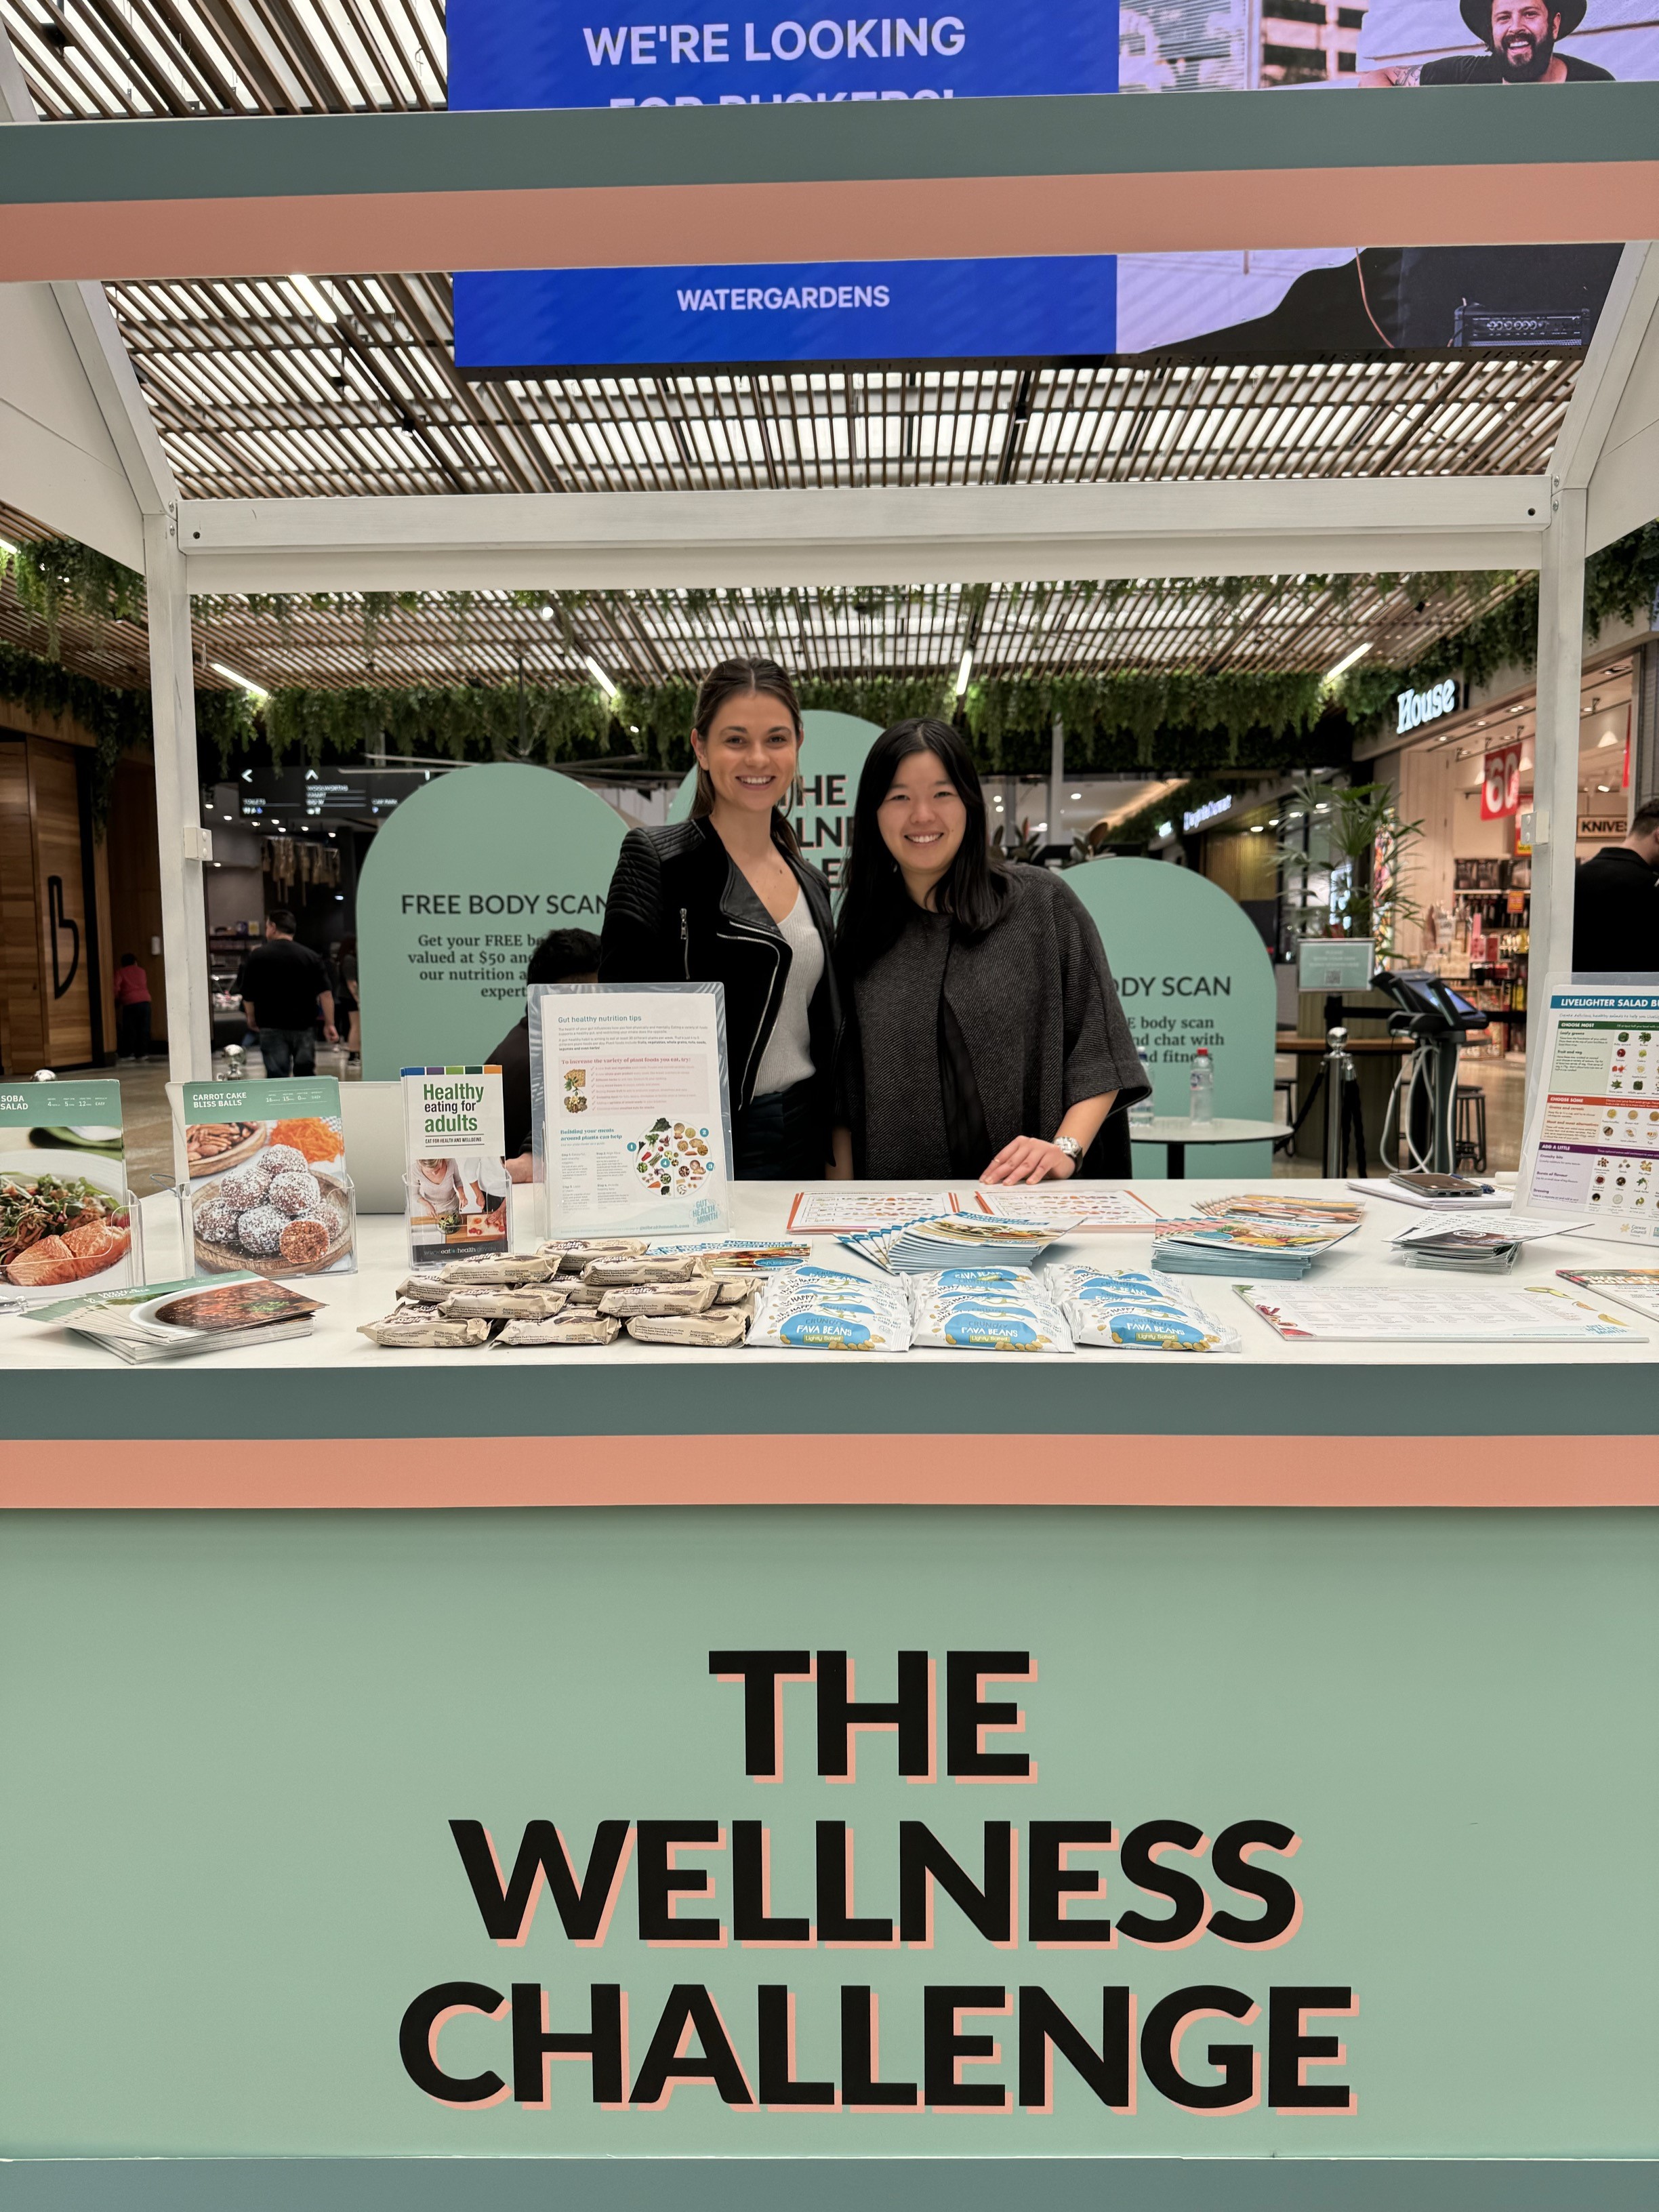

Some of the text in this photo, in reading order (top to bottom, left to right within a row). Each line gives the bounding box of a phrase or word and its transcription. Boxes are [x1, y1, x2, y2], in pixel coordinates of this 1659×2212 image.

[583, 17, 966, 66] WE'RE LOOKING
[678, 285, 890, 312] WATERGARDENS
[1396, 679, 1455, 735] House
[1485, 752, 1519, 813] 60
[779, 775, 847, 807] HE
[402, 895, 462, 914] FREE
[469, 895, 540, 914] BODY
[418, 934, 443, 947] Get
[447, 937, 480, 949] your
[485, 935, 523, 947] FREE
[408, 950, 455, 964] valued
[460, 952, 474, 963] at
[479, 950, 506, 966] $50
[419, 970, 444, 981] our
[449, 967, 514, 981] nutrition
[481, 986, 527, 1000] expert
[1112, 976, 1231, 997] DY SCAN
[1561, 998, 1615, 1007] LIVELIGHTER
[1618, 999, 1648, 1007] SALAD
[1141, 1016, 1176, 1031] body
[1181, 1019, 1214, 1029] scan
[1132, 1033, 1224, 1046] nd chat with
[193, 1092, 224, 1101] CARROT
[423, 1083, 484, 1103] Healthy
[424, 1100, 476, 1114] eating for
[424, 1115, 478, 1132] adults
[693, 1204, 715, 1217] HEALTH
[696, 1199, 708, 1208] GUT
[697, 1212, 718, 1225] MONTH
[1126, 1323, 1185, 1336] FAVA BEANS
[1132, 1319, 1172, 1327] CRUNCHY
[796, 1325, 853, 1337] FAVA BEANS
[988, 1328, 1018, 1338] BEANS
[709, 1651, 1038, 1784] THE
[449, 1820, 1303, 1950] WELLNESS
[399, 1982, 1359, 2116] CHALLENGE
